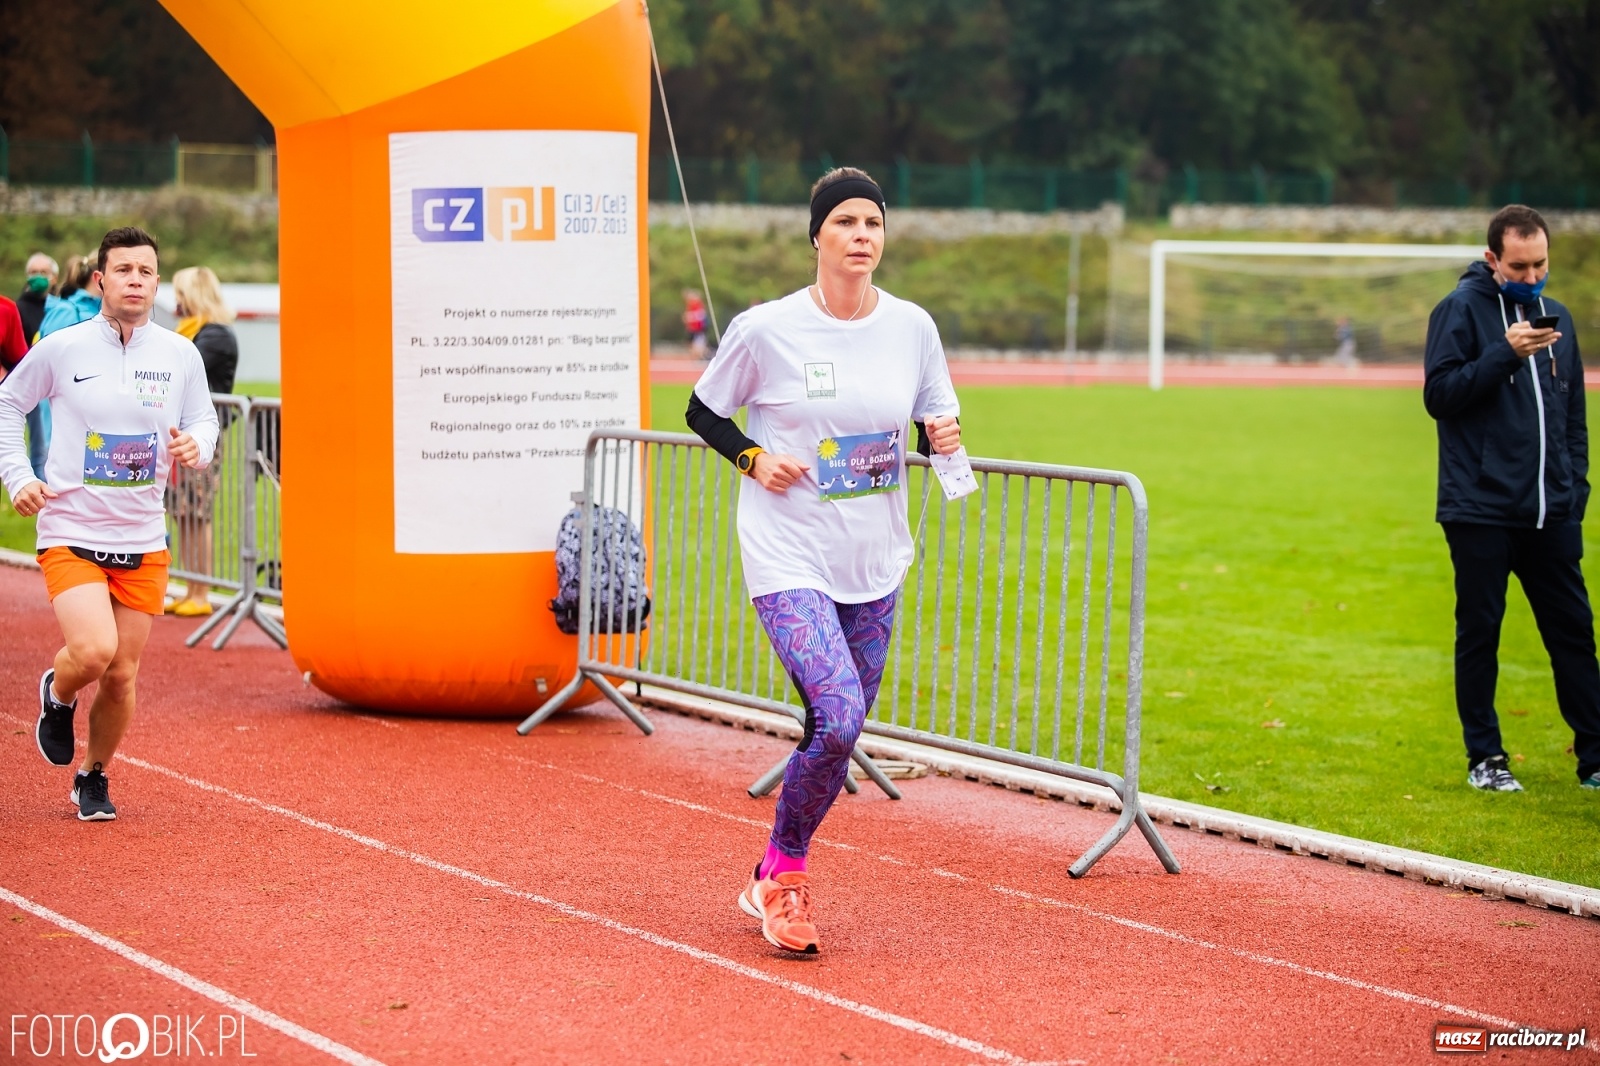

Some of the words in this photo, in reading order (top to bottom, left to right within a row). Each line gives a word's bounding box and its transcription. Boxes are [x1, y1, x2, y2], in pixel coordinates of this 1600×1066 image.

[444, 308, 486, 320] Projekt
[490, 310, 497, 318] o
[501, 308, 548, 317] numerze
[552, 307, 617, 319] rejestracyjnym
[433, 335, 543, 347] 3.22/3.304/09.01281
[596, 335, 609, 344] bez
[420, 365, 441, 378] jest
[445, 363, 552, 377] współfinansowany
[566, 362, 586, 373] 85%
[589, 364, 597, 373] ze
[600, 360, 630, 373] środków
[134, 370, 171, 382] MATEUSZ
[443, 392, 528, 405] Europejskiego
[531, 391, 581, 402] Funduszu
[584, 390, 618, 402] Rozwoju
[430, 421, 512, 434] Regionalnego
[515, 422, 539, 431] oraz
[543, 421, 556, 430] do
[560, 419, 579, 429] 10%
[582, 421, 591, 429] ze
[595, 418, 626, 428] środków
[94, 451, 109, 459] BIEG
[421, 450, 469, 461] budżetu
[473, 450, 521, 462] państwa
[829, 459, 846, 468] BIEG
[850, 457, 865, 467] DLA
[127, 468, 150, 482] 299
[870, 473, 892, 488] 129
